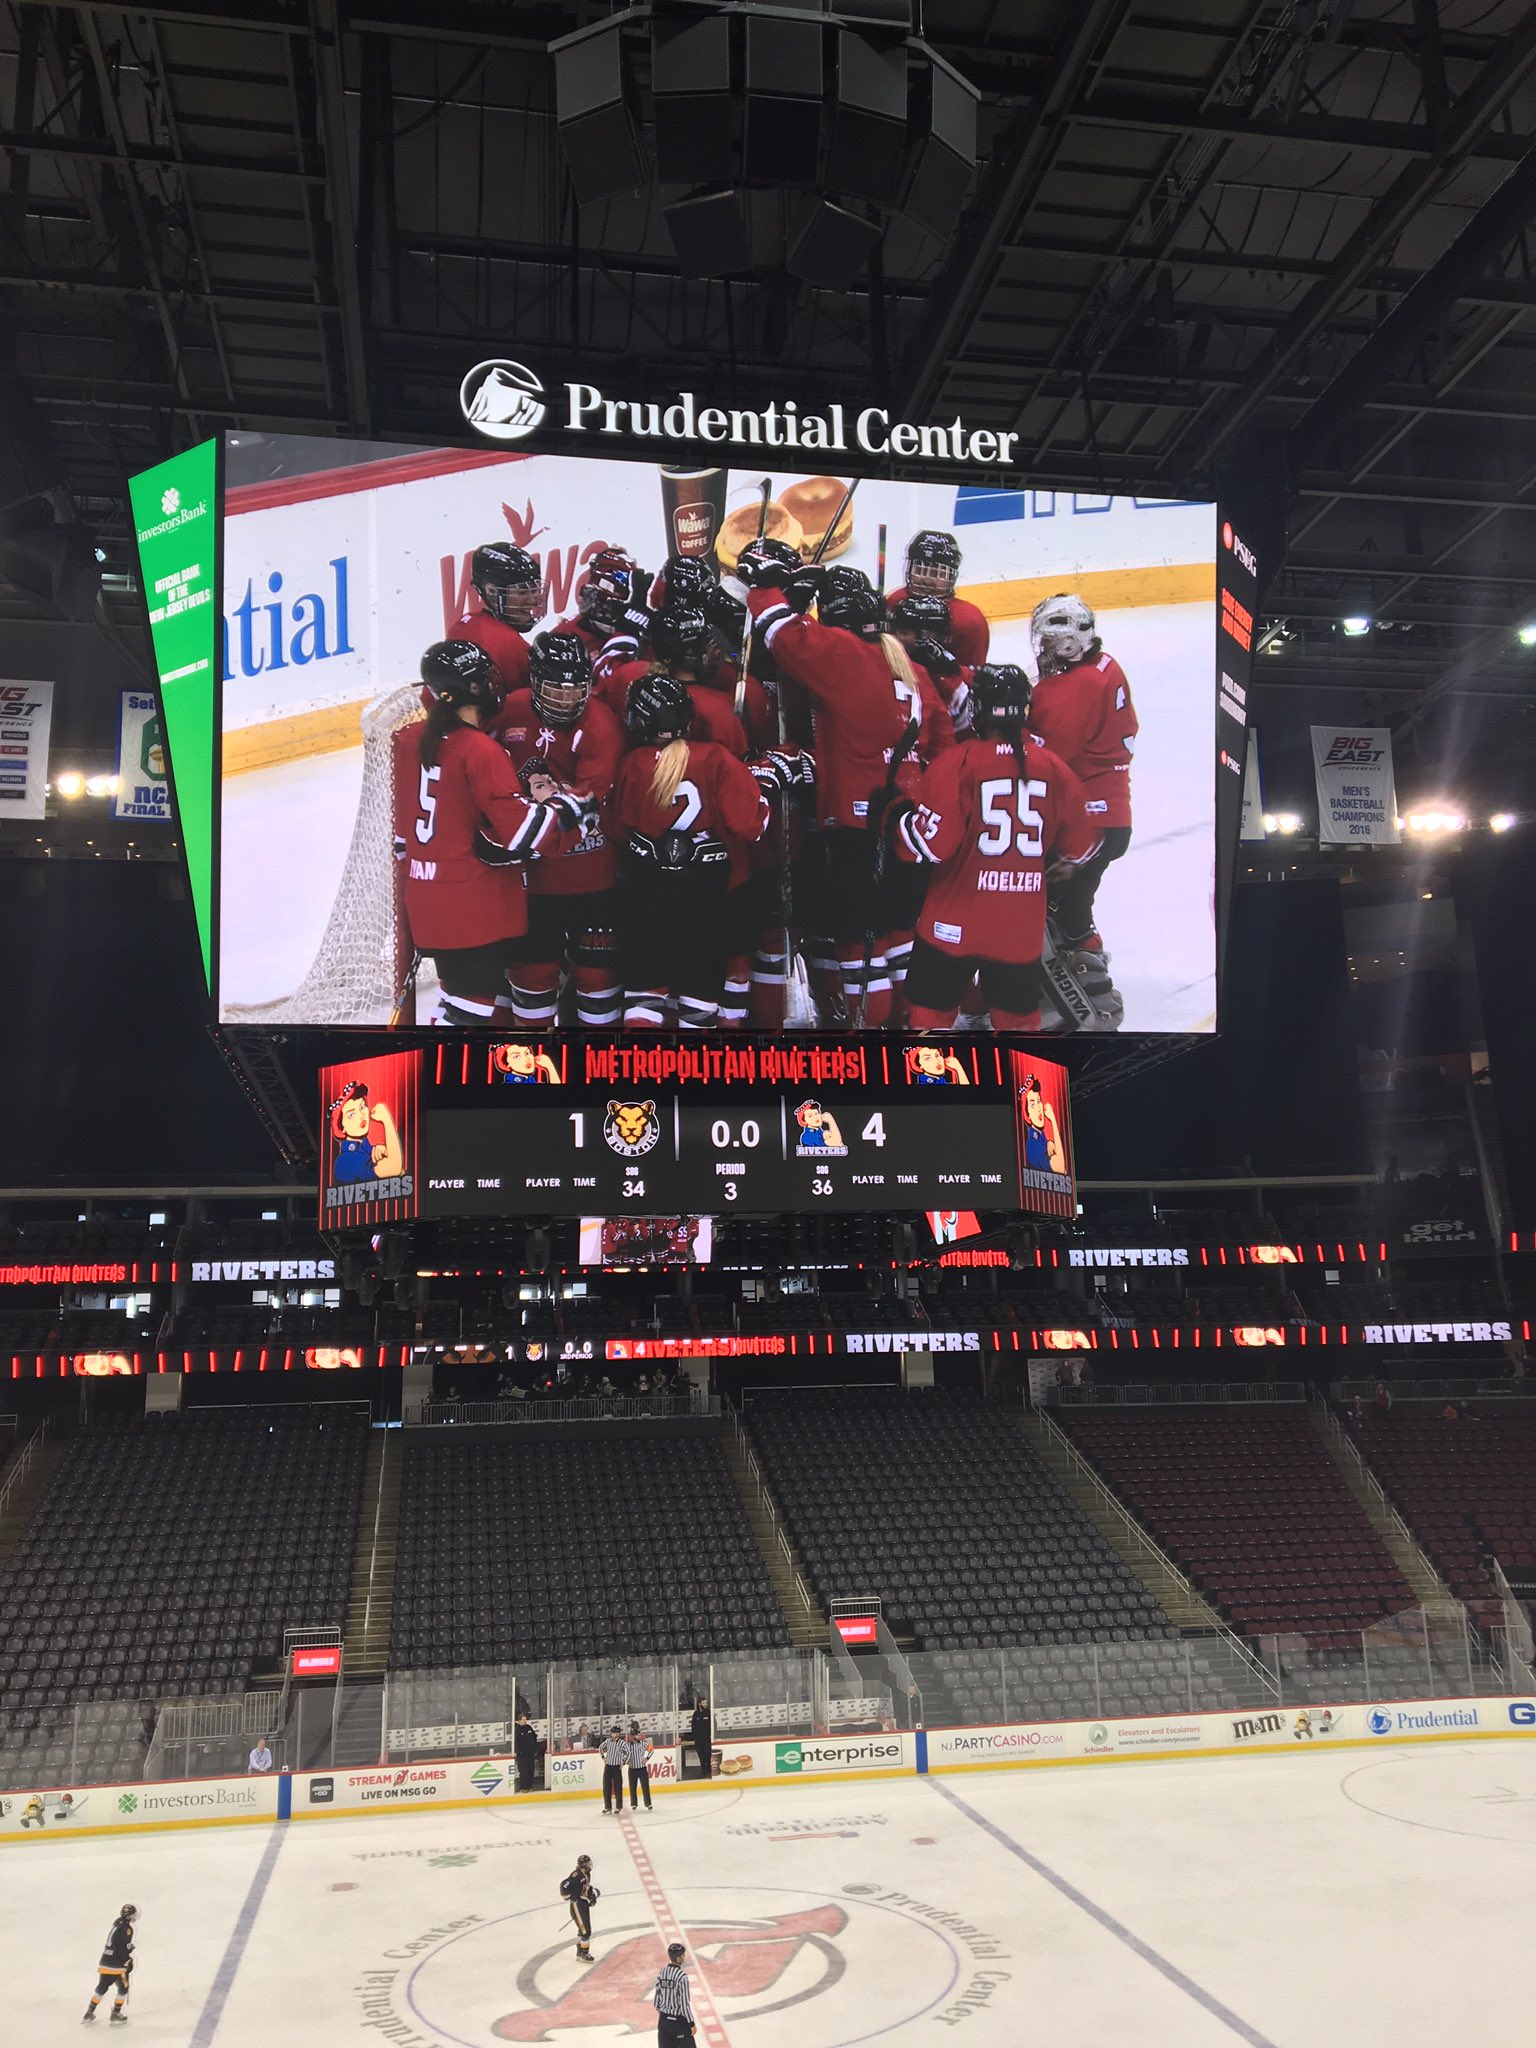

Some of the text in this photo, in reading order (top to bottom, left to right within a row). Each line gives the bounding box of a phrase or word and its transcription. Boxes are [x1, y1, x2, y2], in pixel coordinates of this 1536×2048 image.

[564, 383, 1020, 465] Prudential Center
[138, 501, 209, 543] investorsBank
[681, 536, 708, 549] COFFEE
[1331, 736, 1373, 749] BIG
[1326, 750, 1385, 762] EAST
[1342, 786, 1370, 796] MEN'S
[414, 764, 441, 845] 5
[1330, 798, 1385, 809] BASKETBALL
[977, 778, 1047, 857] 55
[1332, 811, 1385, 822] CHAMPIONS
[1349, 824, 1370, 835] 2016
[977, 870, 1041, 892] KOELZER
[585, 1049, 860, 1080] METROPOLITAN RIVETERS
[568, 1112, 584, 1149] 1
[711, 1120, 760, 1149] 0.0
[861, 1112, 886, 1147] 4
[607, 1133, 658, 1156] BOSTON
[797, 1146, 848, 1156] RIVETERS
[625, 1166, 639, 1176] SOG
[715, 1163, 745, 1175] PERIOD
[816, 1165, 829, 1175] SOG
[429, 1178, 500, 1190] PLAYER TIME
[525, 1177, 596, 1188] PLAYER TIME
[852, 1174, 919, 1185] PLAYER TIME
[938, 1173, 1002, 1184] PLAYER TIME
[1022, 1167, 1073, 1195] RIVETERS
[326, 1175, 413, 1208] RIVETERS
[622, 1180, 645, 1198] 34
[724, 1182, 738, 1201] 3
[811, 1179, 834, 1196] 36
[1410, 1220, 1465, 1236] get
[1069, 1248, 1189, 1267] RIVETERS
[73, 1264, 125, 1283] RIVETERS
[192, 1261, 335, 1281] RIVETERS
[1364, 1321, 1512, 1344] RIVETERS
[564, 1341, 592, 1356] 0.0
[635, 1342, 645, 1356] 4
[735, 1336, 785, 1356] RIVETERS
[846, 1333, 980, 1353] RIVETERS
[504, 1345, 513, 1360] 1
[1397, 1709, 1479, 1729] Prudential
[1118, 1729, 1150, 1737] Elevators
[1166, 1726, 1200, 1734] Escalators
[941, 1732, 1064, 1751] NJ.PARTYCASINO.COM
[1119, 1736, 1201, 1746] www.schindler.com/prucenter
[348, 1770, 447, 1787] STREAM GAMES
[562, 1775, 585, 1784] GAS
[143, 1788, 257, 1809] investorsBank
[361, 1786, 437, 1800] LIVE ON MSG GO
[382, 1914, 486, 1960] Center
[877, 1891, 1012, 2026] Prudential Center
